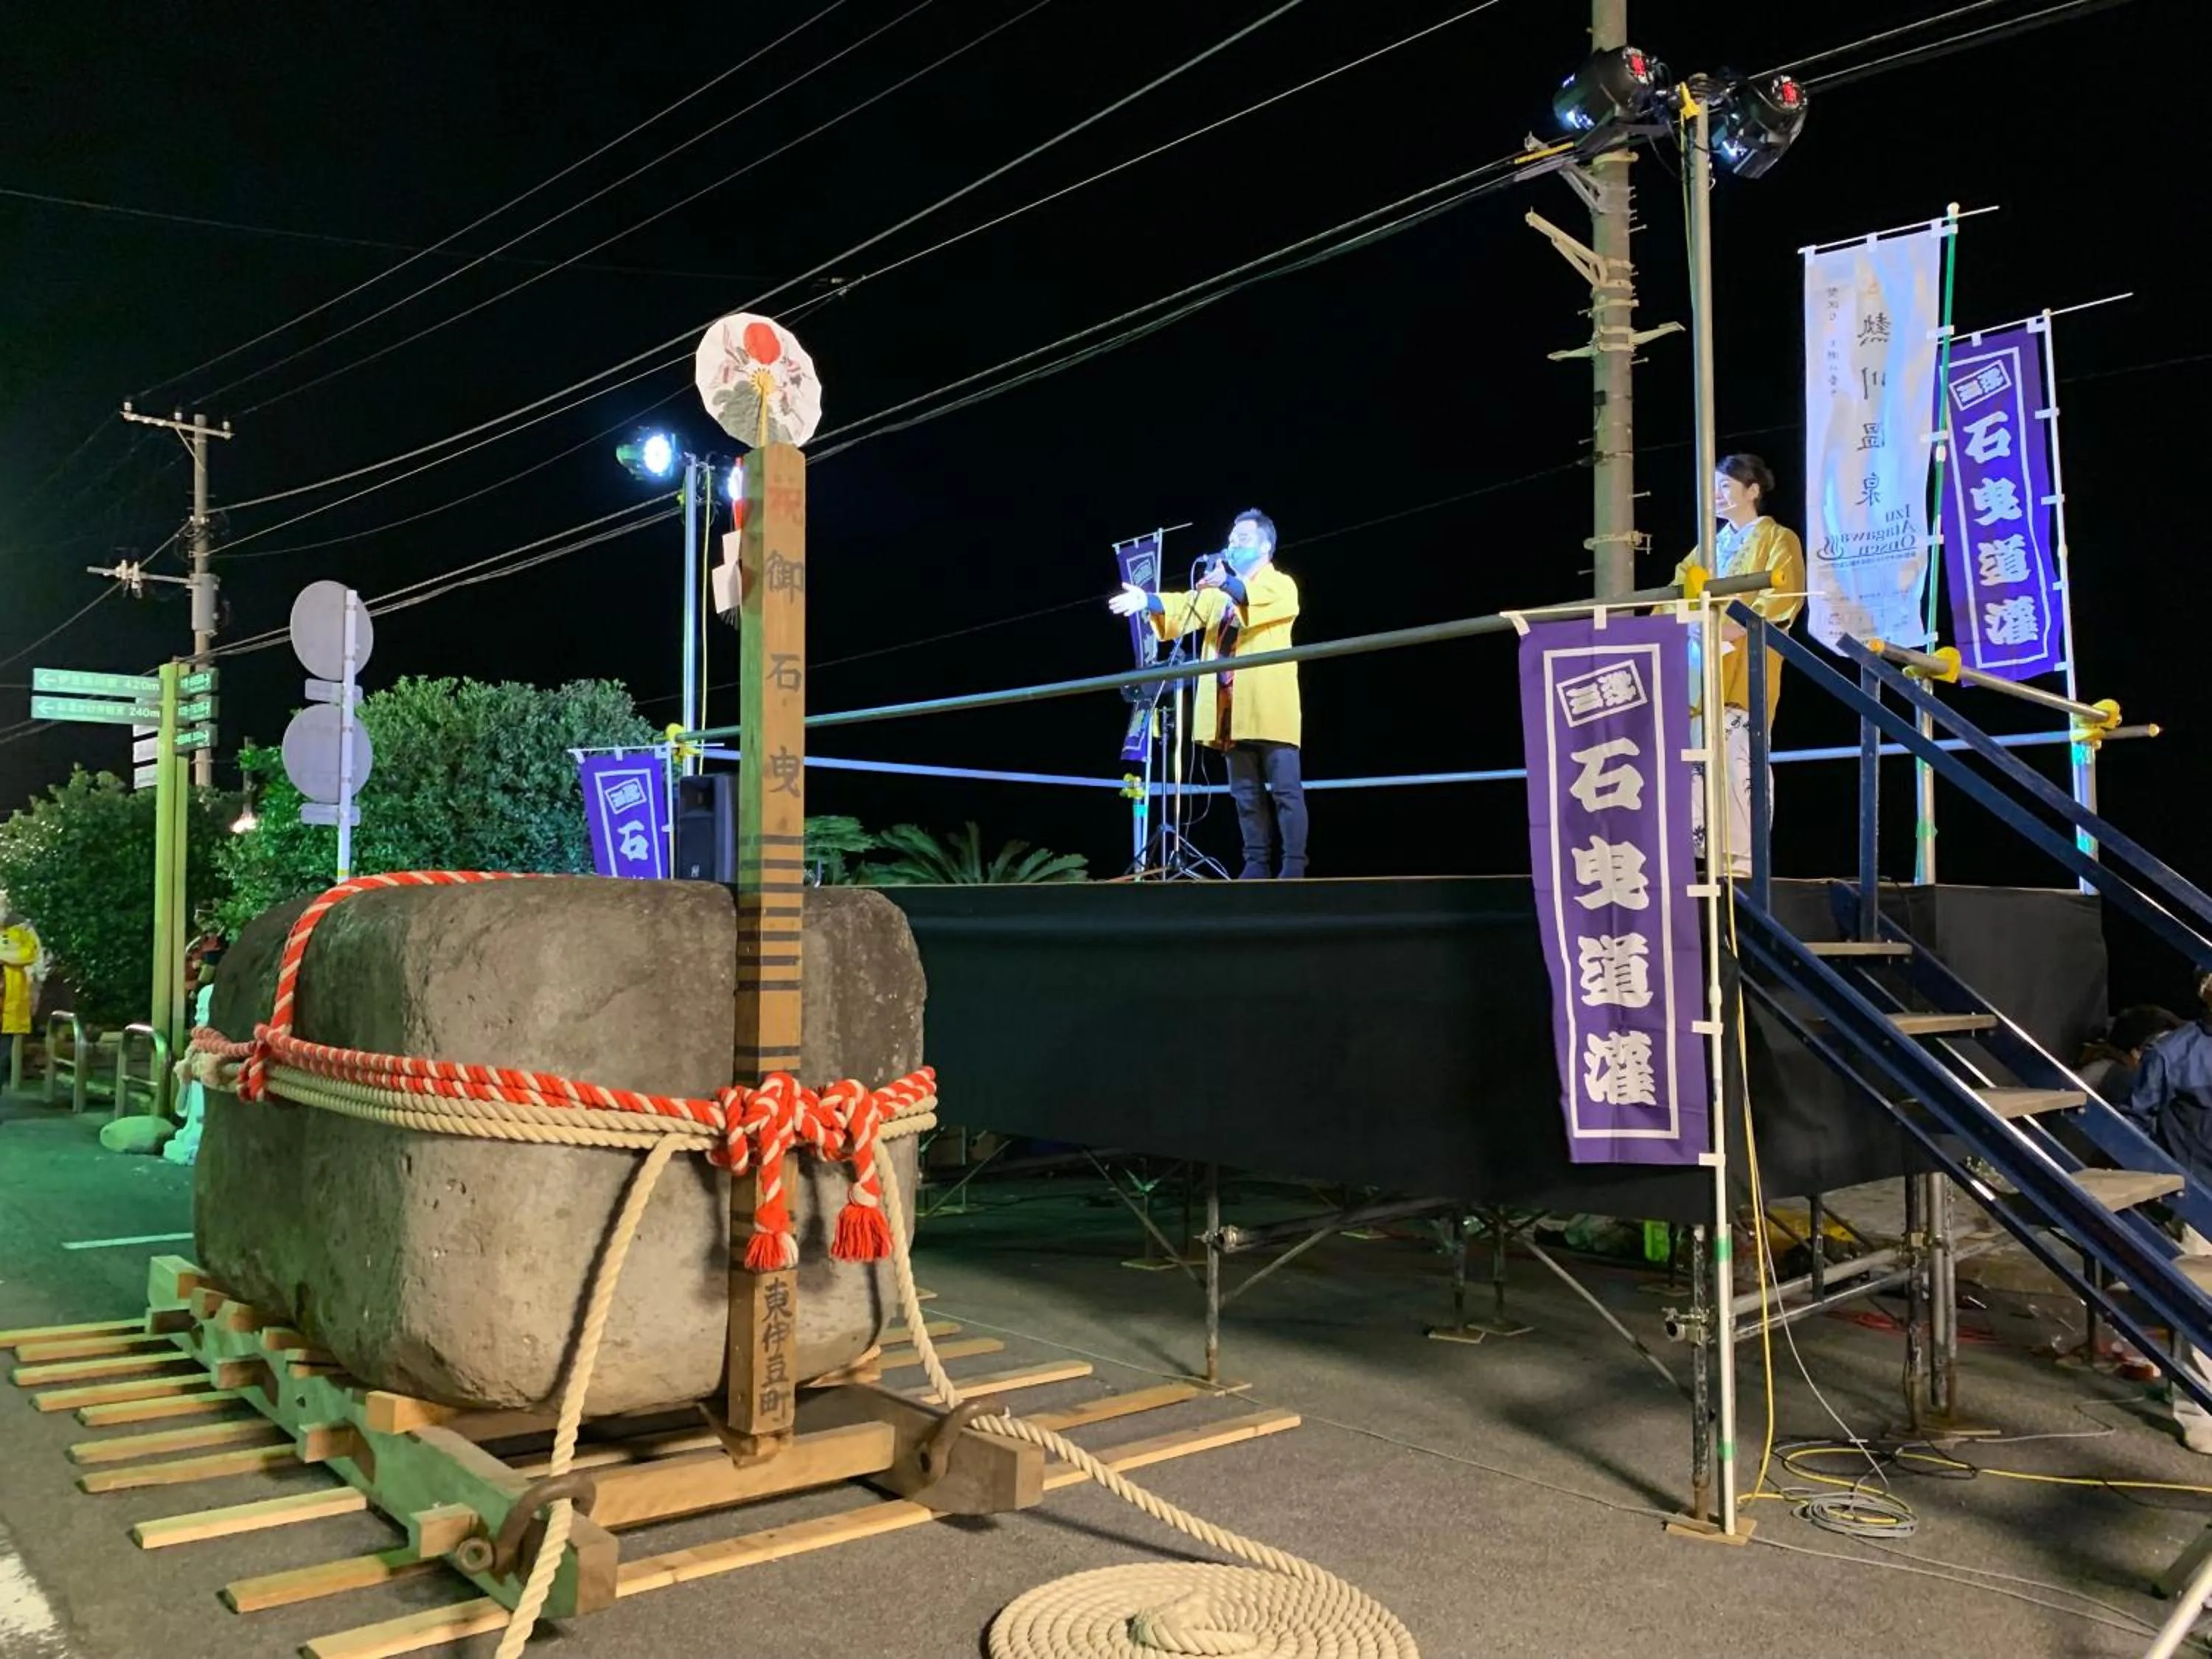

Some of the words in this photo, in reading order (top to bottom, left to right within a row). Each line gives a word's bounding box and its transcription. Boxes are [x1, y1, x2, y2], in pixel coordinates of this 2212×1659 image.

[1963, 410, 2039, 647] 石曳道灌
[129, 706, 160, 718] 240m
[616, 819, 649, 880] 石
[1571, 737, 1657, 1106] 石曳道灌
[759, 1276, 793, 1419] 東伊豆町
